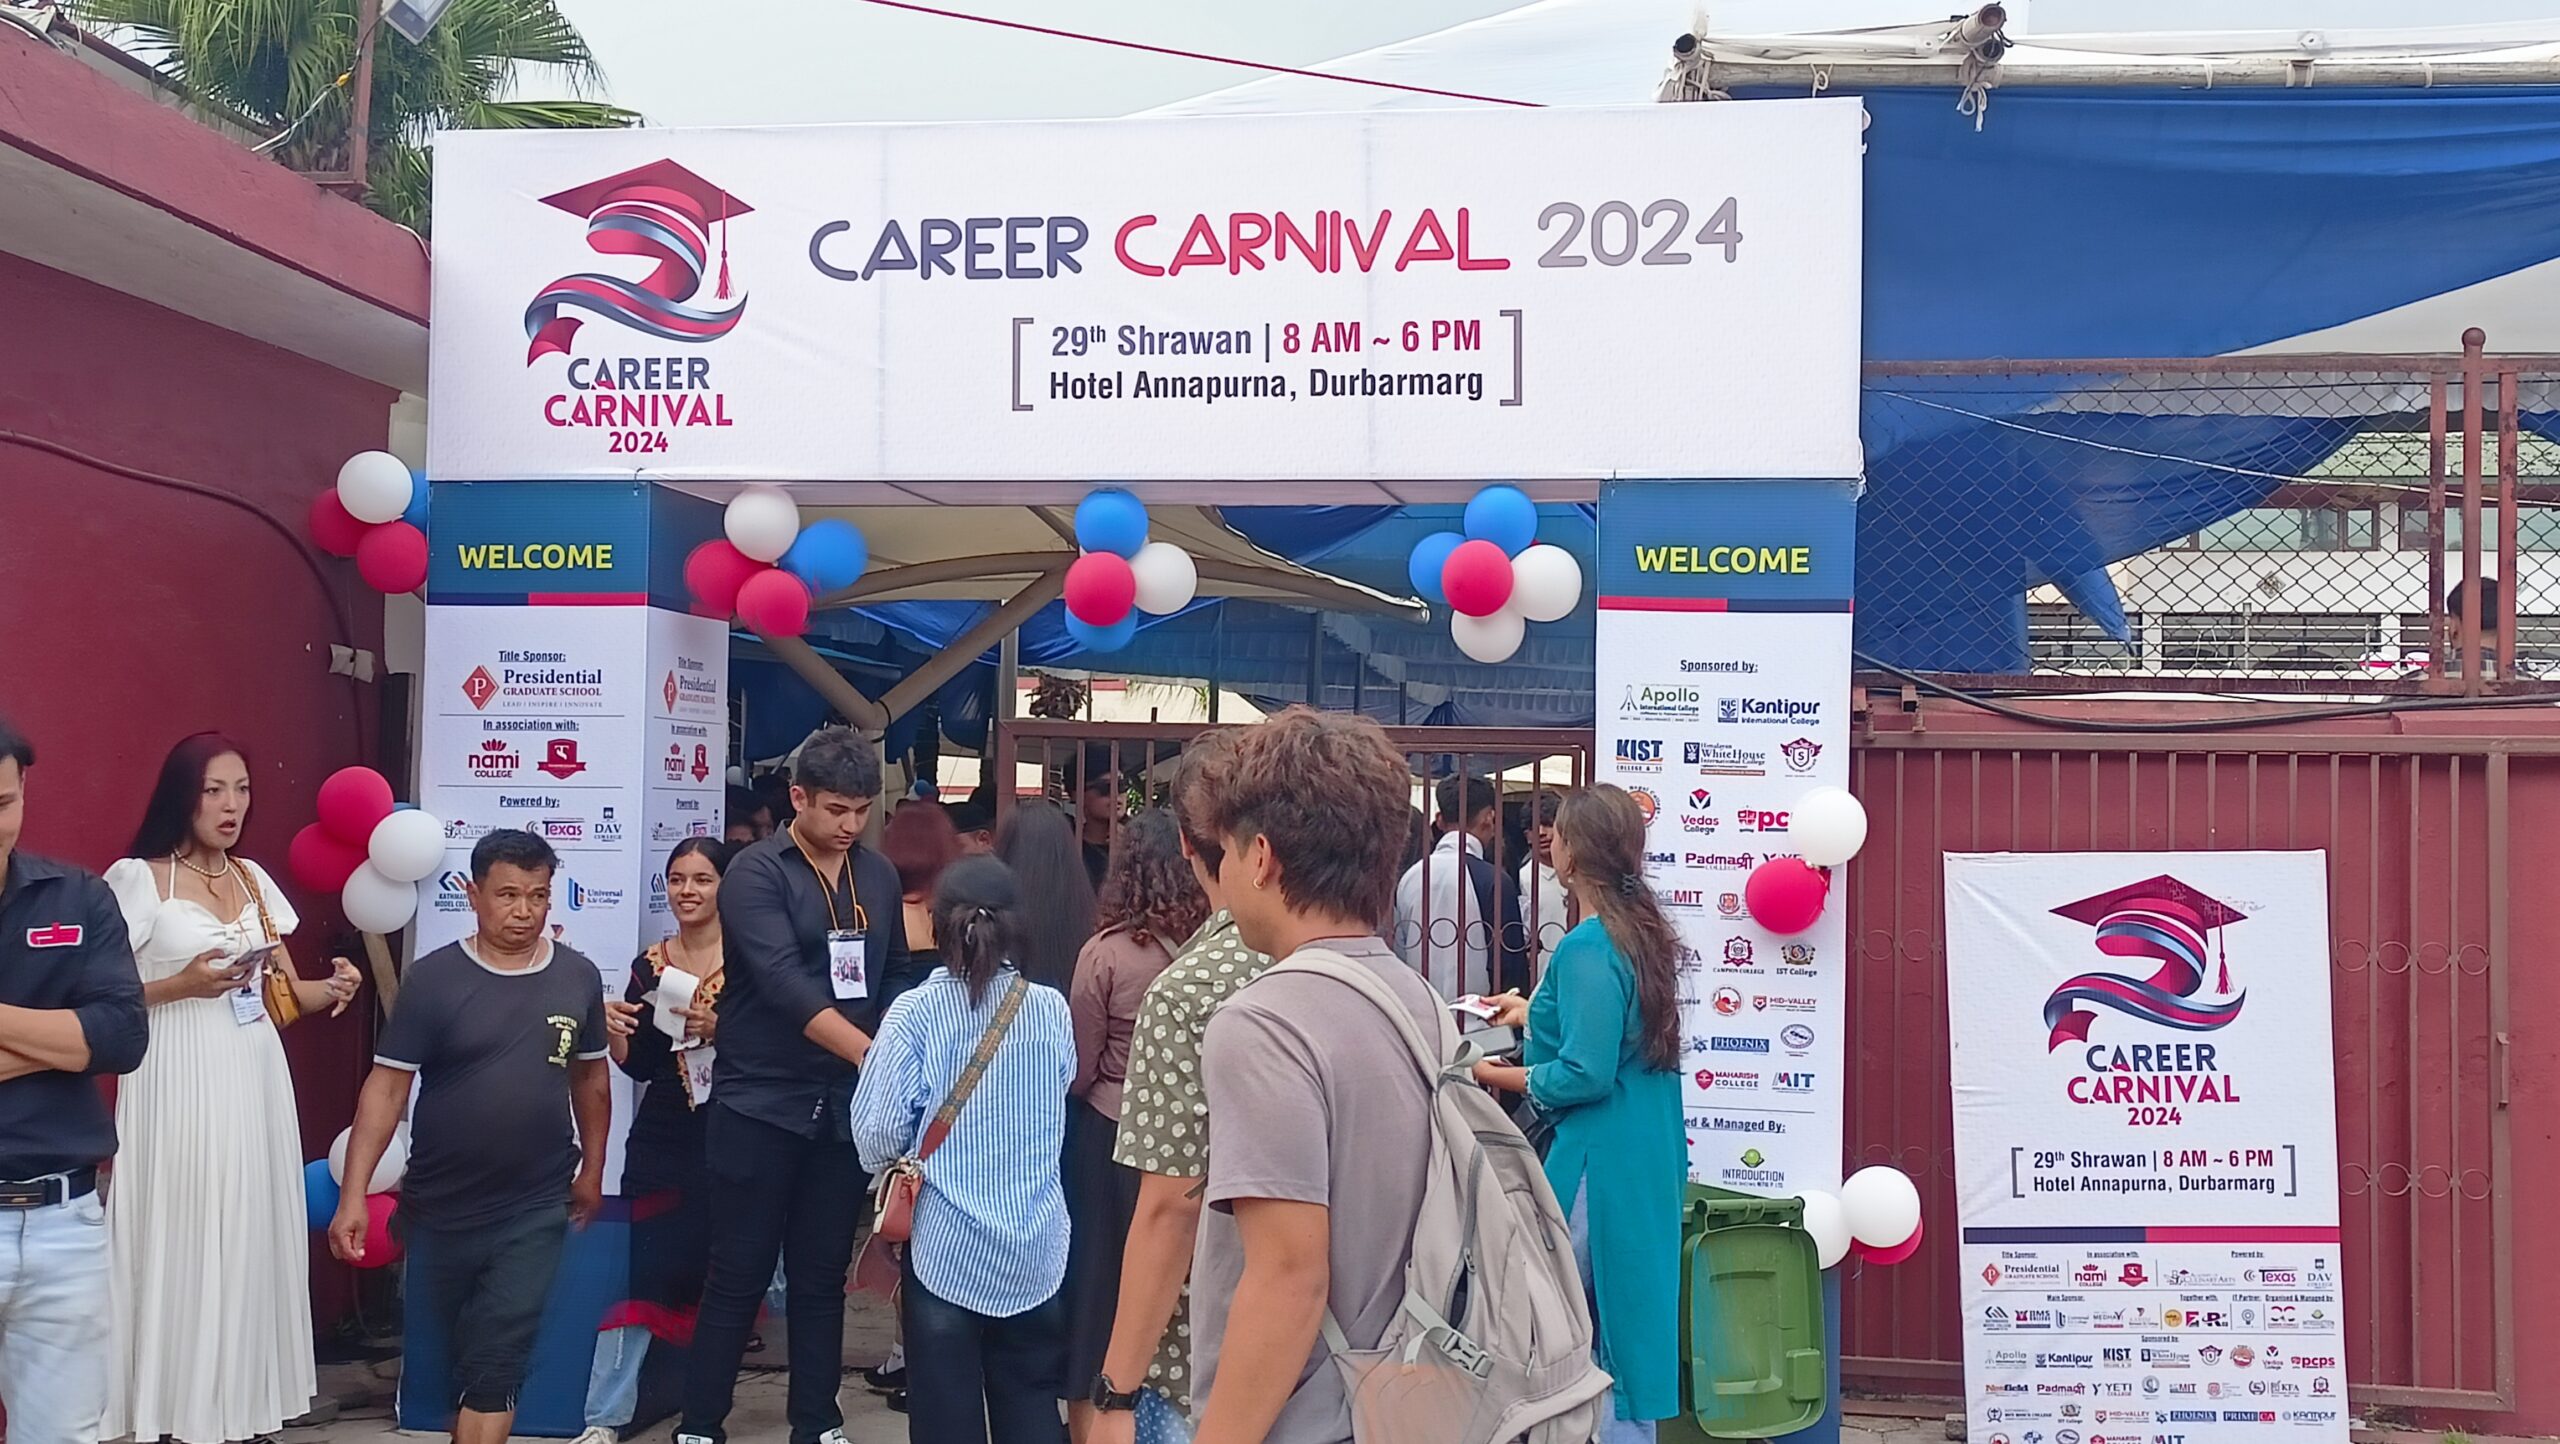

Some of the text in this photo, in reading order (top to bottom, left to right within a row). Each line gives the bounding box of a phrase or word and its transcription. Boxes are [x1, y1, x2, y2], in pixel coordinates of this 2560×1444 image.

[808, 196, 1744, 282] CAREER CARNIVAL 2024
[1051, 323, 1106, 357] 29th
[1117, 322, 1252, 356] Shrawan
[1282, 324, 1301, 355] 8
[1311, 321, 1362, 354] AM
[1401, 320, 1420, 353] 6
[1432, 319, 1482, 352] PM
[567, 357, 711, 391] CAREER
[1050, 367, 1484, 404] Hotel Annapurna, Durbarmarg
[544, 393, 734, 428] CARNIVAL
[608, 430, 669, 454] 2024
[457, 543, 613, 570] WELCOME
[1635, 545, 1810, 574] WELCOME
[499, 650, 566, 663] Title Sponsor:
[1680, 659, 1758, 673] Sponsored by:
[504, 669, 602, 685] Presidential
[472, 678, 487, 698] P
[503, 687, 602, 696] GRADUATE SCHOOL
[1641, 687, 1699, 705] Apollo
[1742, 698, 1820, 718] Kantipur
[483, 719, 580, 732] In association with:
[1791, 718, 1820, 726] College
[1616, 739, 1663, 761] KIST
[468, 750, 519, 769] nami
[474, 770, 512, 778] COLLEGE
[500, 795, 560, 808] Powered by:
[1681, 814, 1719, 826] Vedas
[1758, 811, 1790, 832] pc
[542, 821, 583, 836] Texas
[595, 823, 622, 834] DAV
[1683, 825, 1715, 835] College
[587, 889, 623, 898] Universal
[1789, 968, 1818, 978] College
[1770, 997, 1817, 1005] MID-VALLEY
[1714, 1038, 1768, 1051] PHOENIX
[2086, 1043, 2217, 1072] CAREER
[2067, 1074, 2240, 1104] CARNIVAL
[2127, 1107, 2182, 1126] 2024
[1701, 1117, 1786, 1134] & Managed By:
[2034, 1151, 2065, 1169] 29th
[2071, 1150, 2147, 1168] Shrawan
[2163, 1151, 2173, 1168] 8
[2179, 1150, 2207, 1167] AM
[2229, 1150, 2239, 1167] 6
[2245, 1150, 2274, 1167] PM
[1722, 1168, 1785, 1182] INTRODUCTION
[2034, 1174, 2275, 1194] Hotel Annapurna, Durbarmarg
[2004, 1264, 2060, 1273] Presidential
[2074, 1270, 2107, 1282] nami
[2259, 1269, 2296, 1283] Texas
[2307, 1273, 2333, 1282] DAV
[1996, 1351, 2027, 1360] Apollo
[2048, 1353, 2093, 1365] Kantipur
[2103, 1348, 2131, 1361] KIST
[2302, 1356, 2335, 1368] pcps
